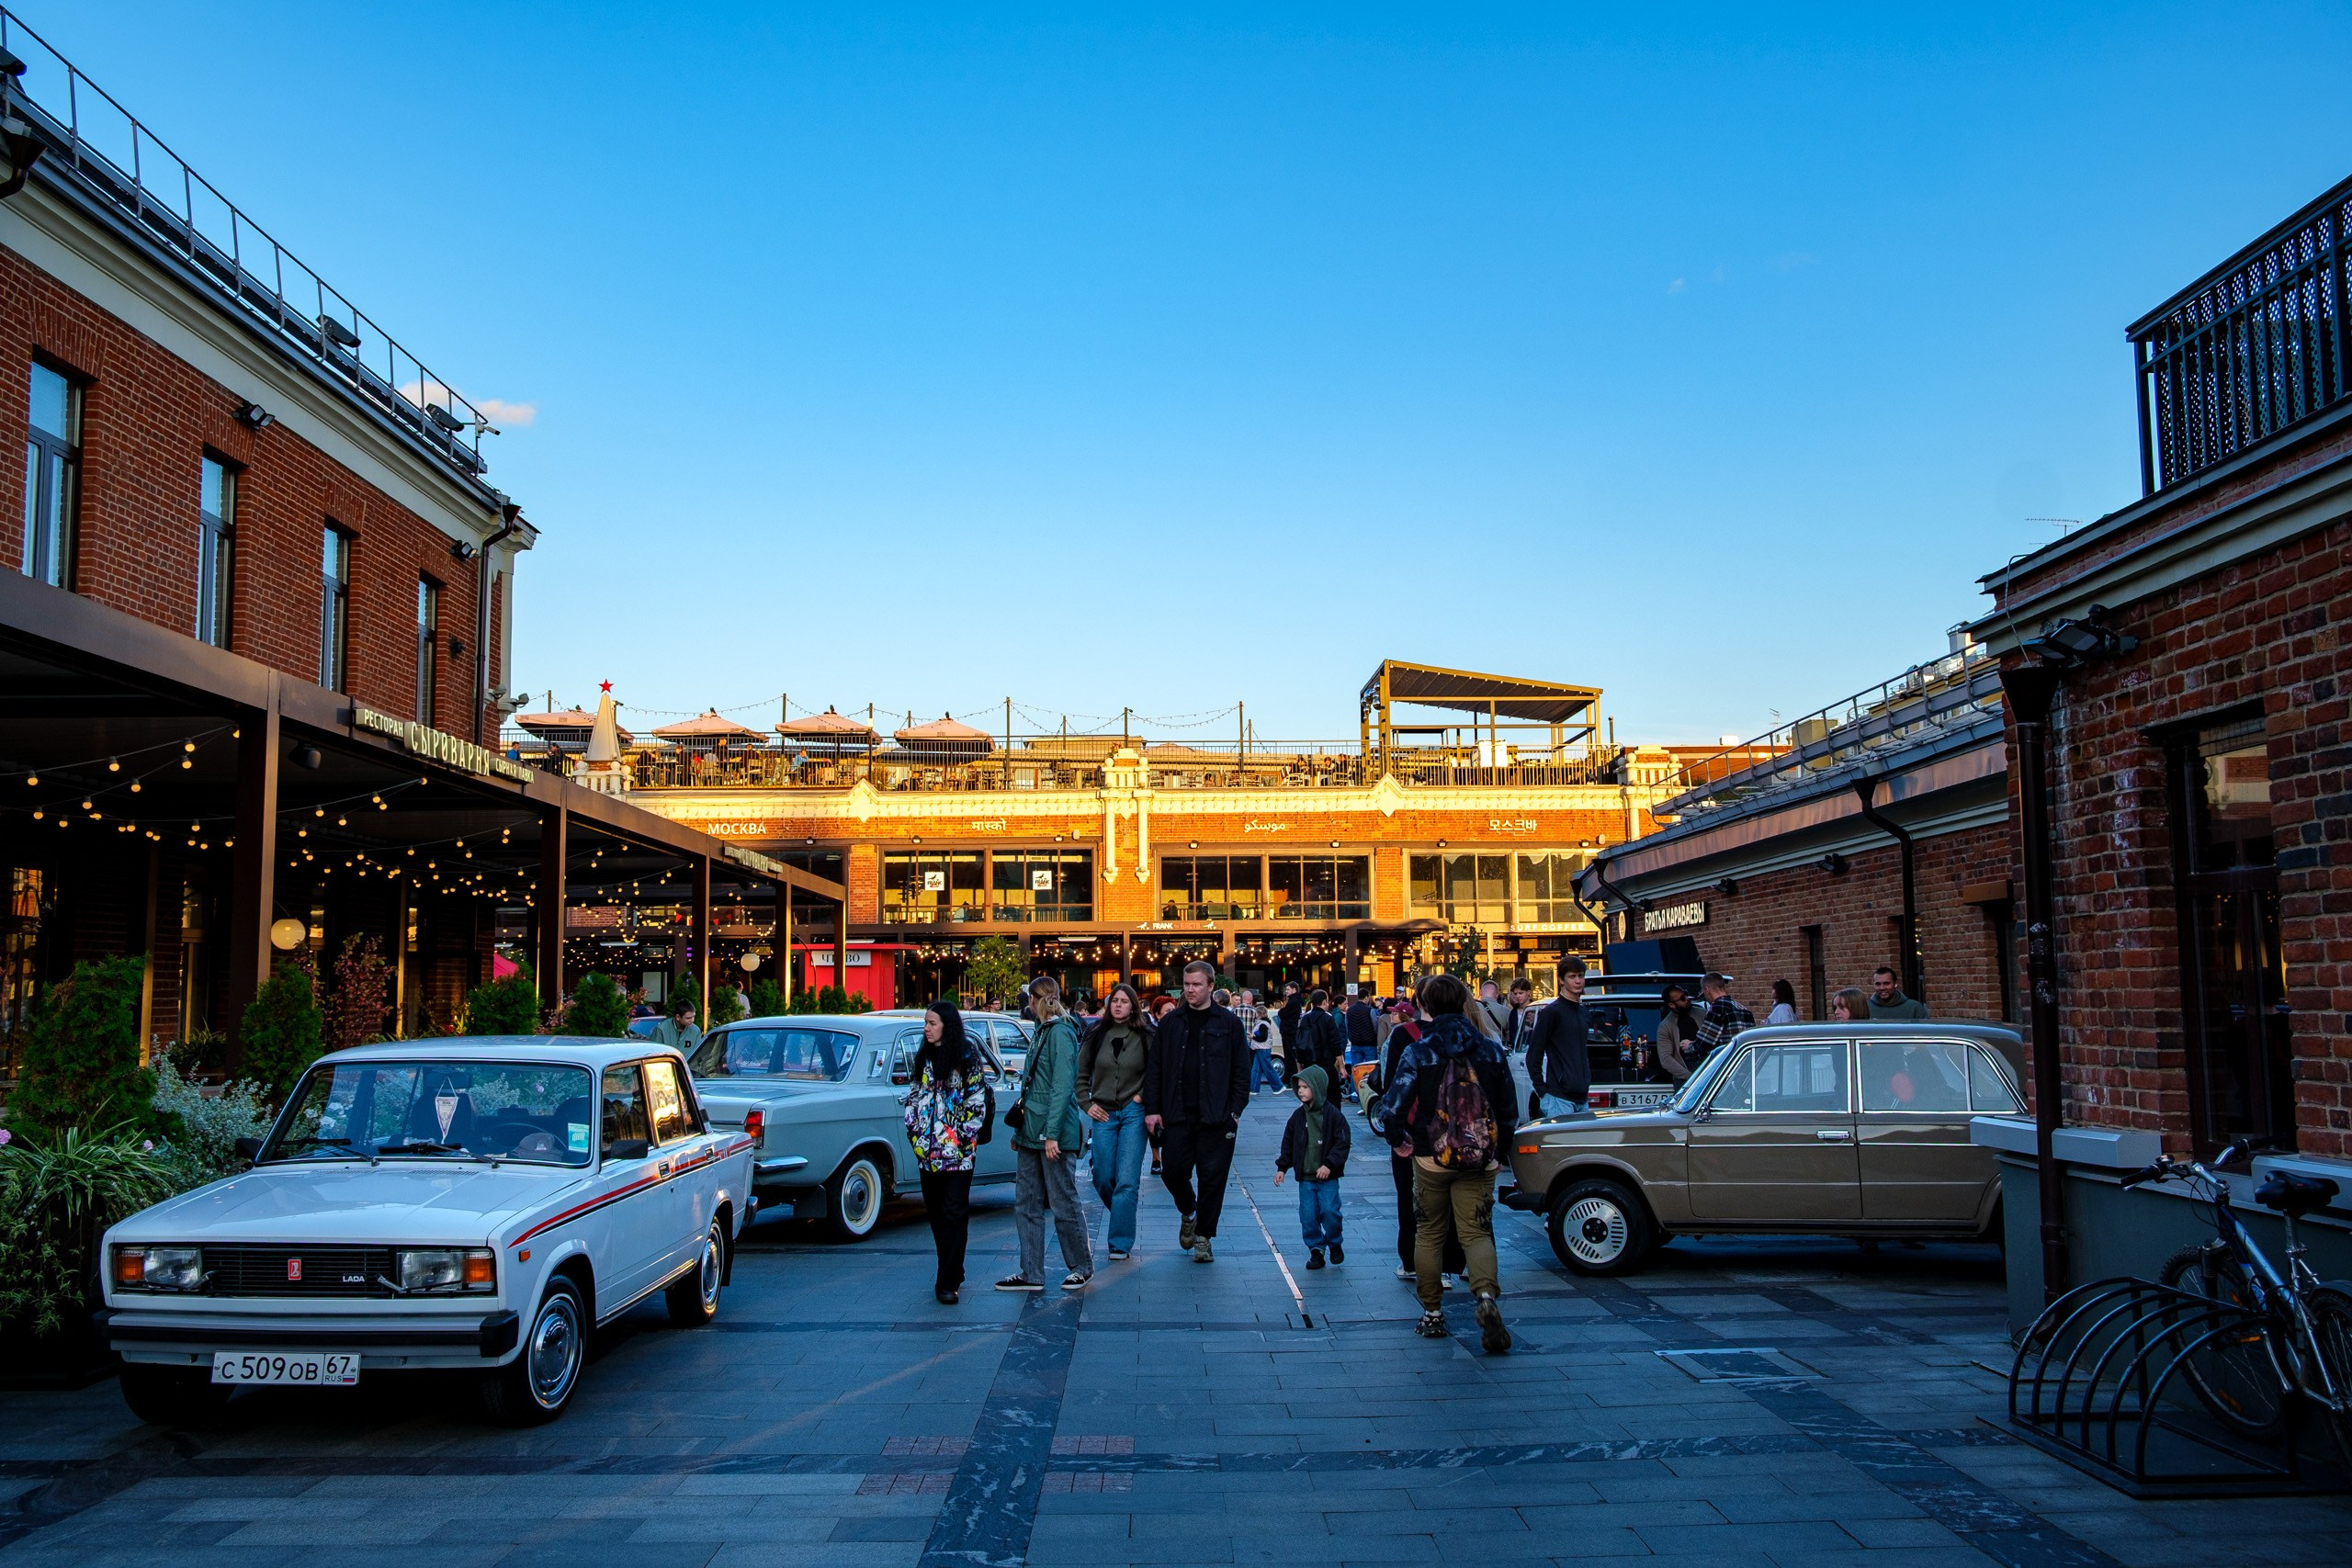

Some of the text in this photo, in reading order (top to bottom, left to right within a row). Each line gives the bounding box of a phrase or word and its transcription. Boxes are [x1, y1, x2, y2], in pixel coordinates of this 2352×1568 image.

[364, 709, 403, 738] РЕСТОРАН
[495, 758, 517, 778] СЫРНАЯ
[707, 823, 766, 834] МОСКВА
[971, 818, 1006, 831] मास्को
[1244, 819, 1285, 833] موسكو
[1488, 819, 1537, 831] 모스크바
[1645, 908, 1666, 932] БРАТЬЯ
[1666, 901, 1704, 928] КАРАВАЕВЫ
[821, 953, 860, 964] ЧТВО
[326, 1356, 351, 1374] 67
